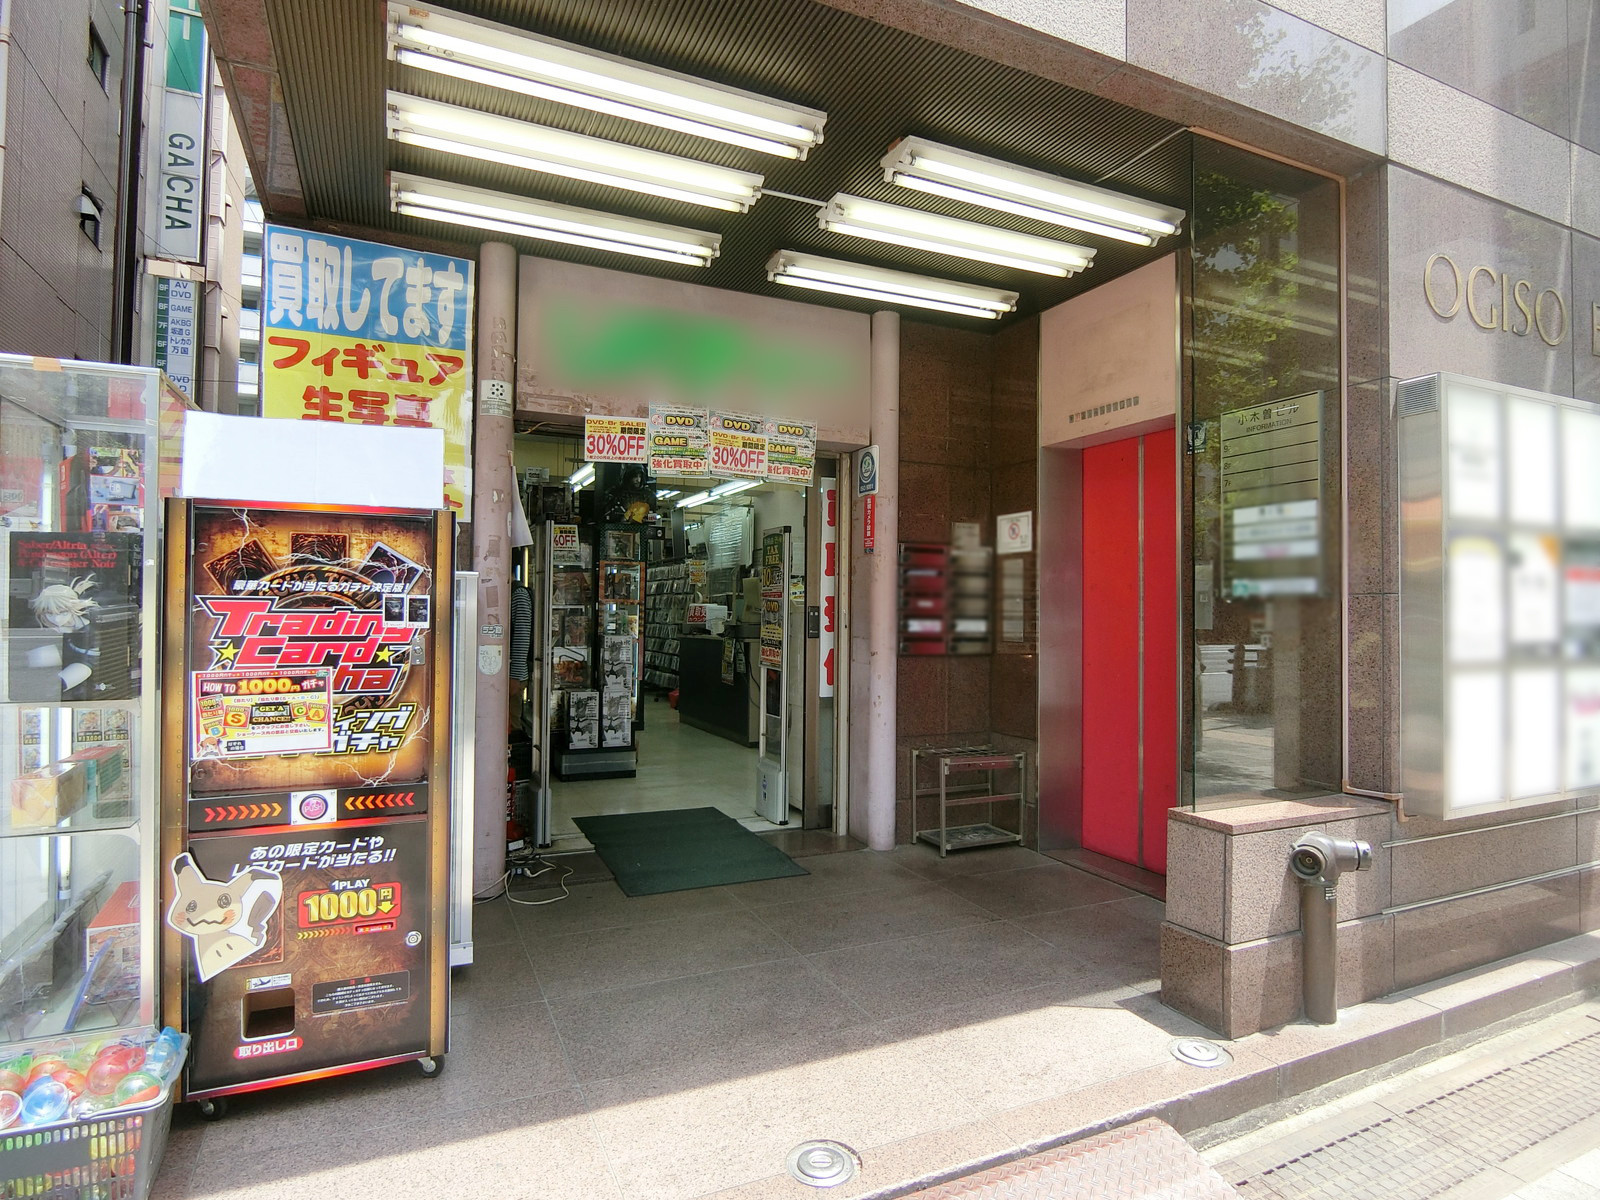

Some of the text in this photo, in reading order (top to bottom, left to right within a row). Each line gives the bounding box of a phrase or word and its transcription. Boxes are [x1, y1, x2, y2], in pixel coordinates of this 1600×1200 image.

[165, 132, 196, 232] GACHA
[158, 283, 170, 292] 9F
[174, 281, 189, 290] AV
[269, 231, 465, 345] 買取してます
[170, 290, 192, 299] DVD
[1423, 251, 1568, 347] OGISO
[158, 302, 169, 311] 8F
[170, 304, 193, 314] GAME
[157, 321, 168, 330] 7F
[170, 318, 192, 327] AKBG
[156, 340, 168, 348] 6F
[169, 336, 192, 346] トレカの
[156, 359, 167, 367] 5F
[267, 335, 464, 387] フィギュア
[301, 384, 433, 427] 生写真
[665, 415, 695, 426] DVD
[723, 418, 751, 431] DVD
[1245, 417, 1294, 433] INFORMATION
[778, 424, 805, 436] DVD
[586, 433, 647, 457] 30%OFF
[654, 435, 688, 446] GAME
[768, 443, 796, 455] GAME
[711, 446, 766, 470] 30%OFF
[652, 458, 707, 471] 強化買取中!
[232, 579, 410, 594] 豪華カードが当たるガチャ決定版!
[237, 638, 378, 666] Card
[202, 682, 224, 693] HOW
[224, 683, 236, 693] TO
[301, 679, 325, 691] ガチャ
[230, 713, 242, 724] S
[312, 709, 321, 719] A
[249, 835, 385, 861] あの限定カードや
[331, 878, 371, 891] 1PLAY
[238, 1037, 299, 1057] 取り出し口
